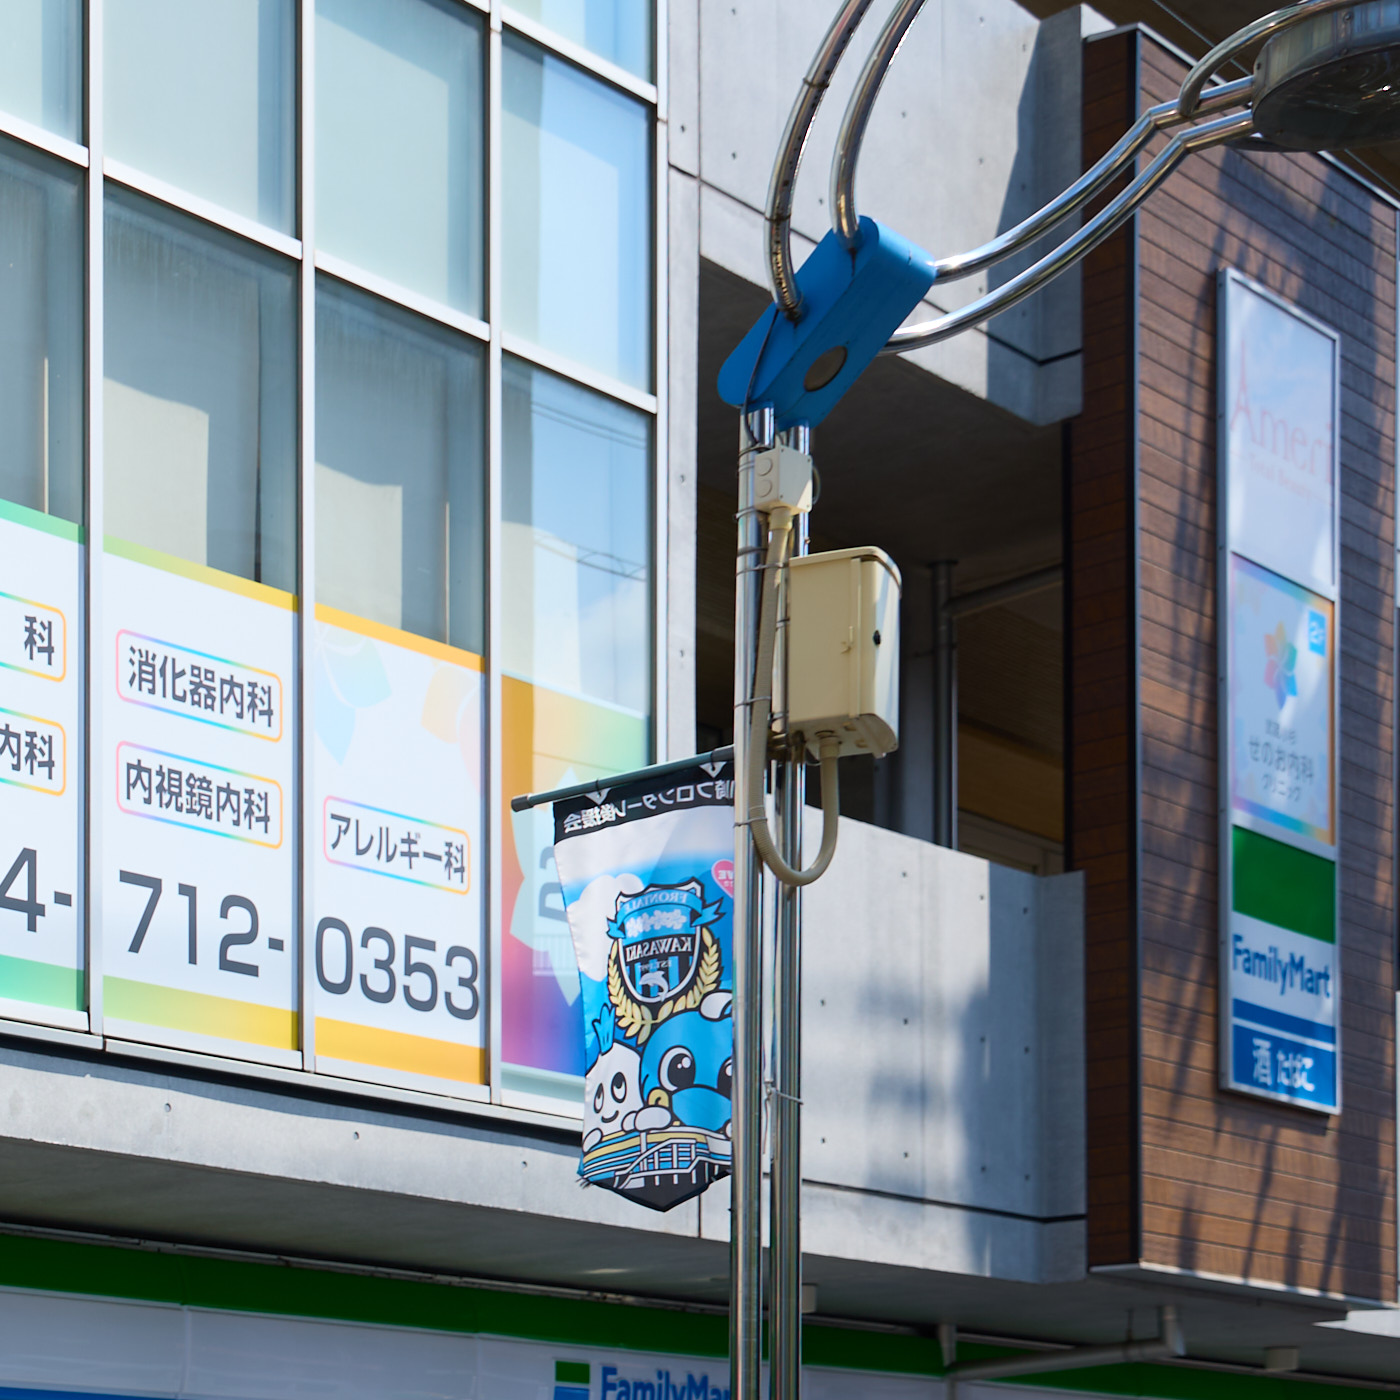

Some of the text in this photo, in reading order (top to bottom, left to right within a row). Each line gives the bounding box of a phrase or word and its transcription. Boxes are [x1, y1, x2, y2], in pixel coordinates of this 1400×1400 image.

[128, 646, 274, 729] 消化器内科
[125, 759, 271, 834] 内視鏡内科
[329, 812, 466, 885] アレルギー科
[1232, 933, 1332, 999] FamilyMart
[1252, 1037, 1273, 1087] 酒
